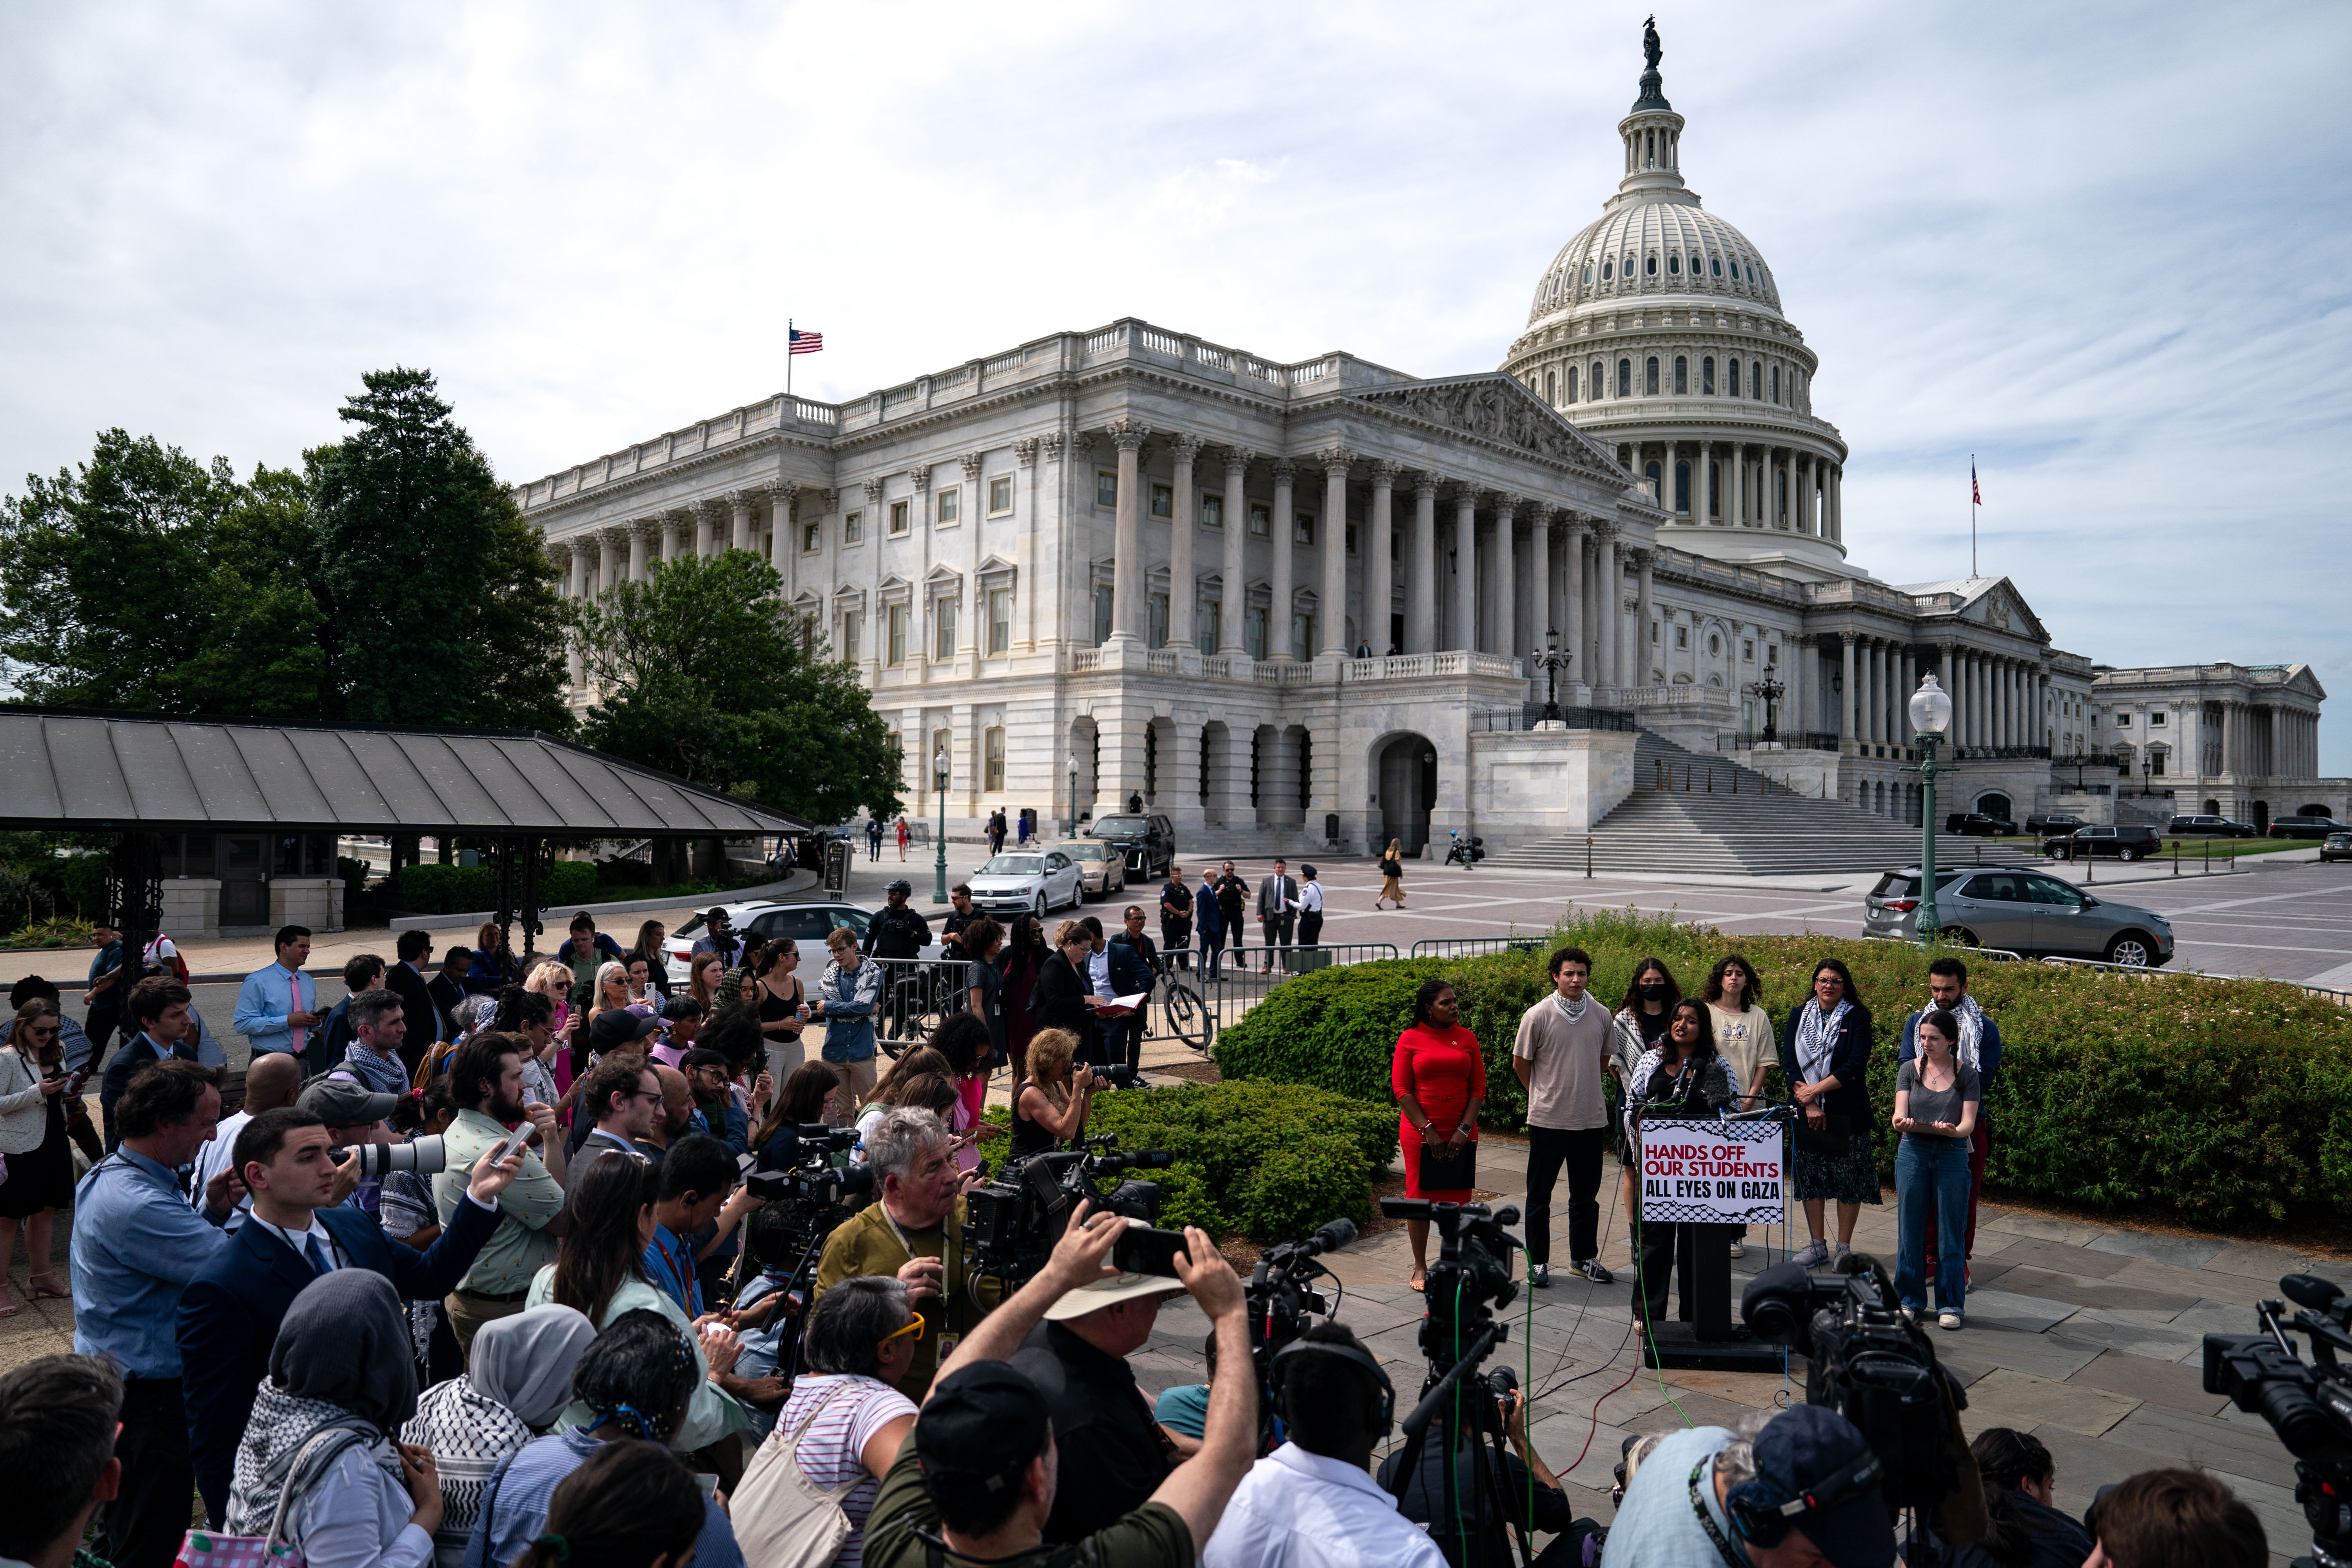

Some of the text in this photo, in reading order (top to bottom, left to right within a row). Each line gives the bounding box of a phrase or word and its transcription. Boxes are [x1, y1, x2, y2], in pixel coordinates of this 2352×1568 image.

[1645, 1144, 1746, 1160] HANDS OFF
[1645, 1161, 1779, 1178] OUR STUDENTS
[1646, 1179, 1780, 1200] ALL EYES ON GAZA
[2330, 1400, 2351, 1414] SONY
